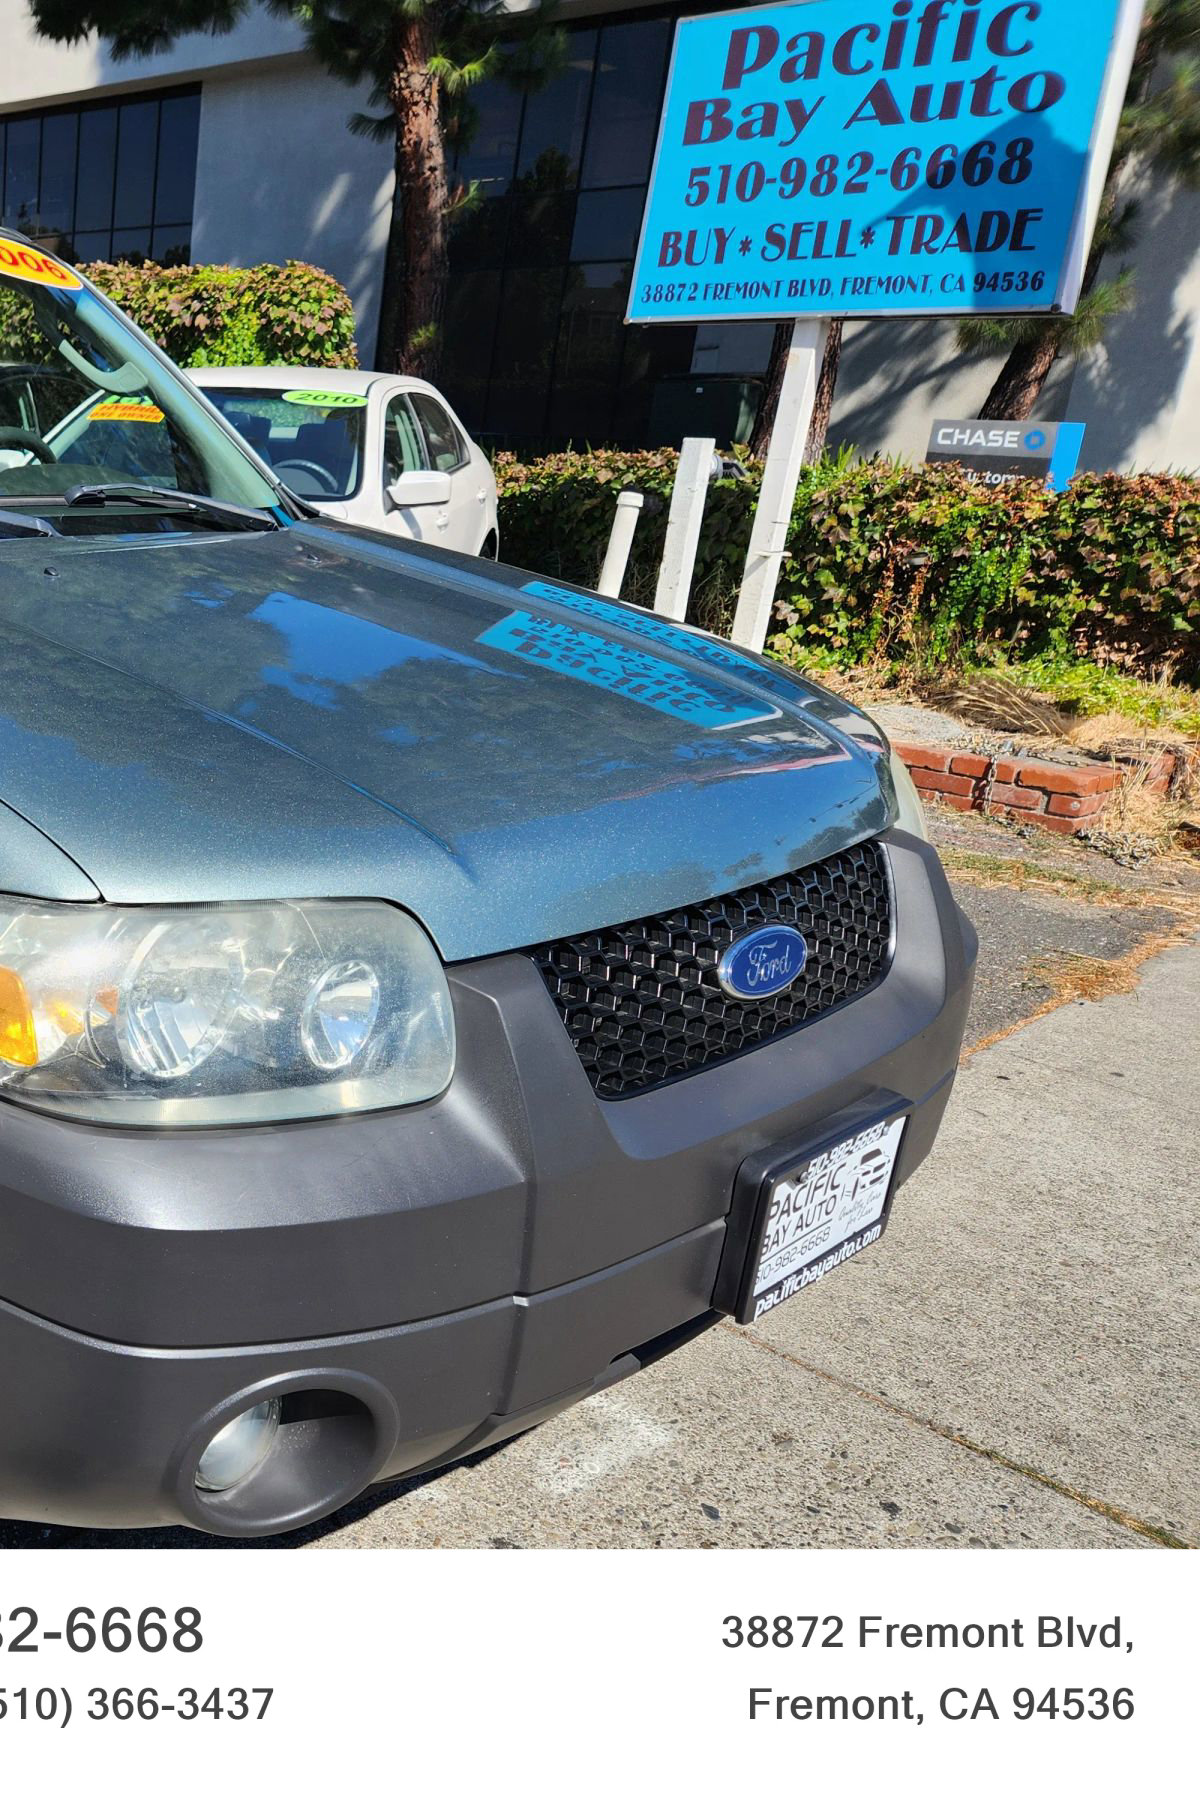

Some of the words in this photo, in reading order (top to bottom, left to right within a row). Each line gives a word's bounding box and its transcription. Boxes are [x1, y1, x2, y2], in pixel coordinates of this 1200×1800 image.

[722, 0, 1042, 90] Pacific
[682, 97, 826, 146] Bay
[842, 65, 1066, 130] Auto
[684, 137, 1034, 207] 510-982-6668
[657, 226, 736, 267] BUY
[760, 219, 857, 262] SELL
[886, 208, 1044, 256] TRADE
[641, 282, 699, 303] 38872
[703, 280, 785, 301] FREMONT
[840, 274, 934, 296] FREMONT,
[940, 273, 965, 293] CA
[972, 270, 1045, 293] 94536
[293, 392, 358, 404] 2010
[937, 428, 1021, 448] CHASE
[746, 940, 791, 987] Ford
[792, 1194, 837, 1238] AUTO
